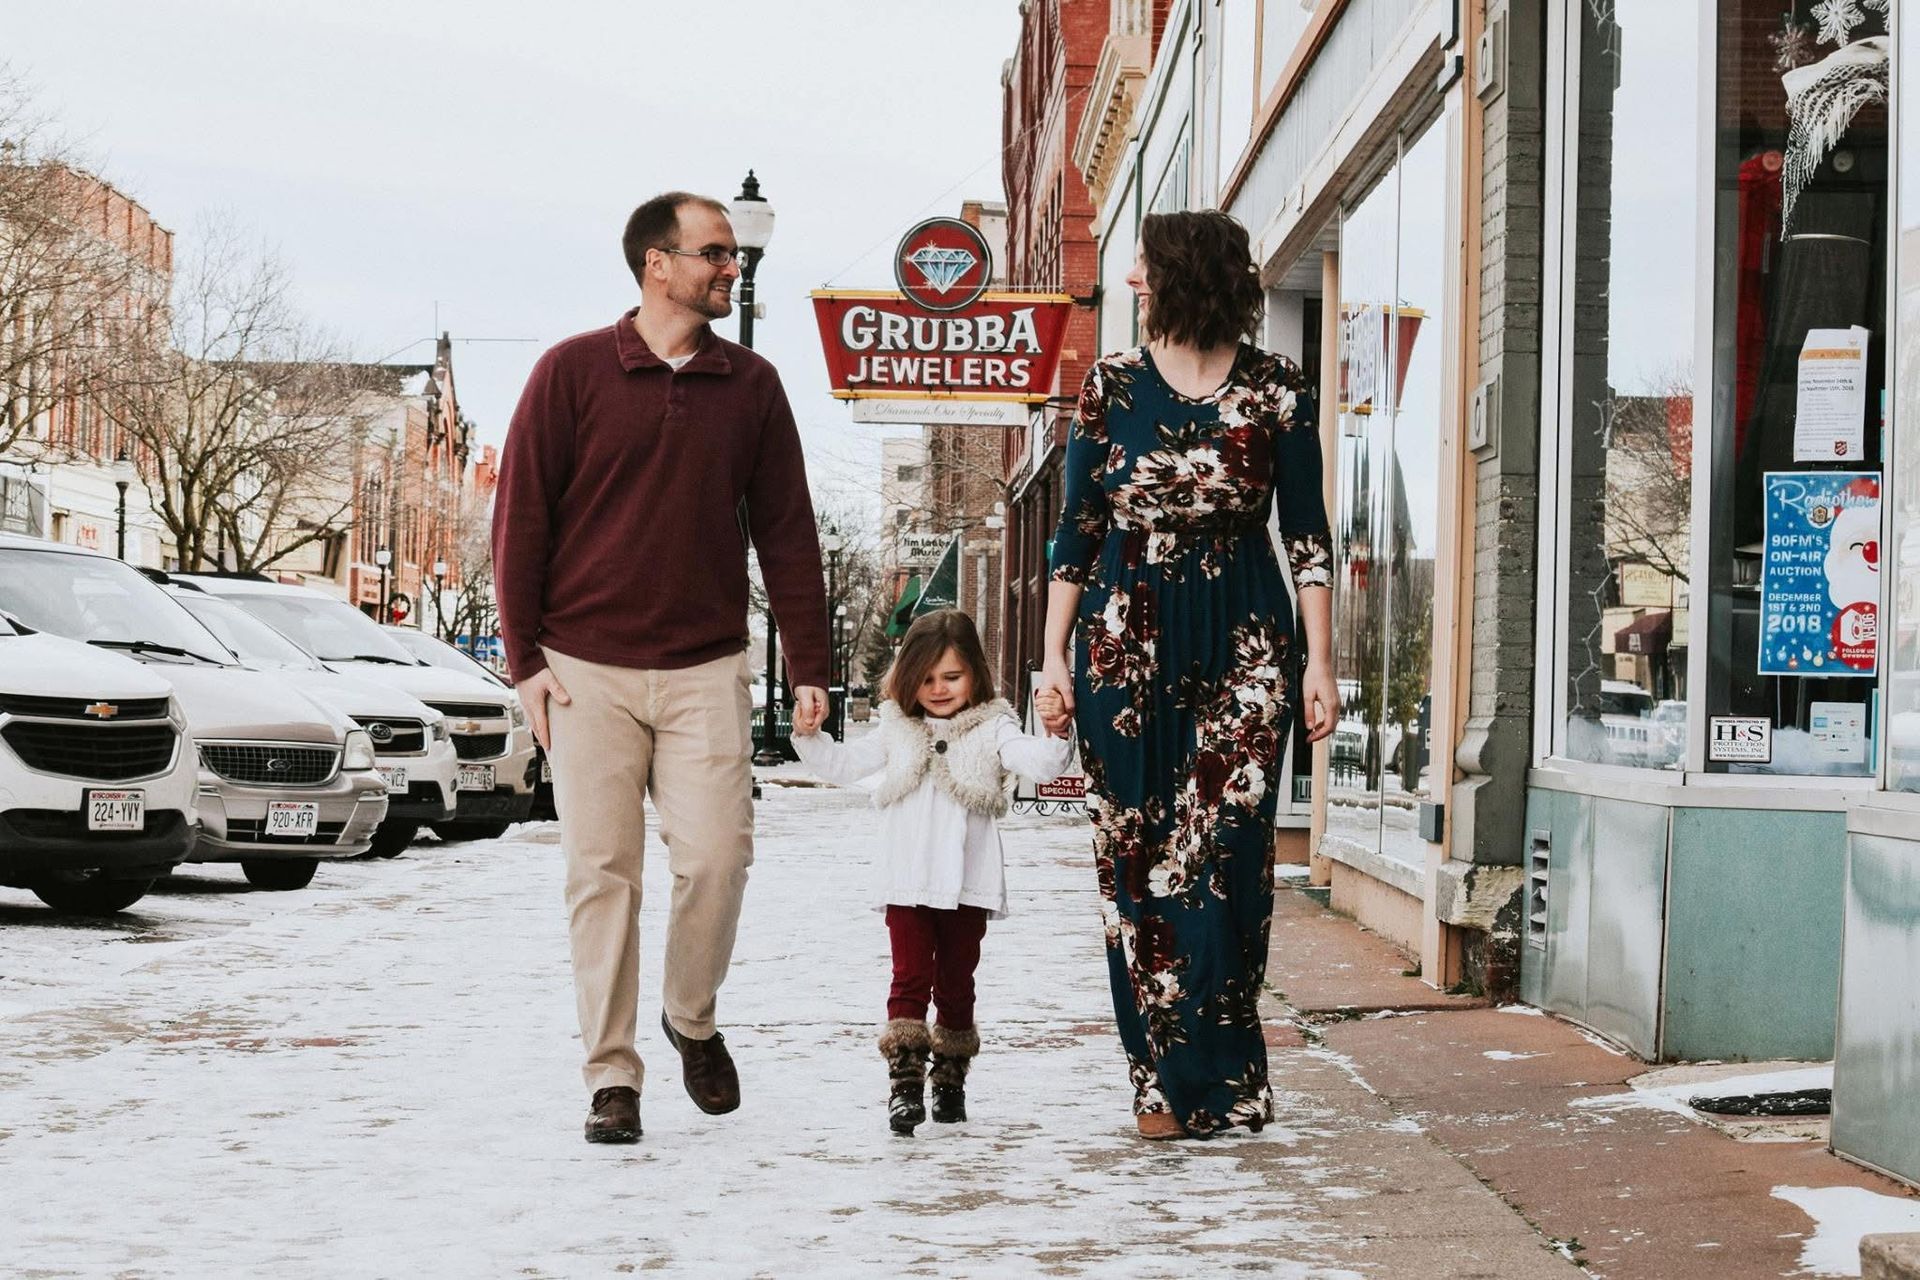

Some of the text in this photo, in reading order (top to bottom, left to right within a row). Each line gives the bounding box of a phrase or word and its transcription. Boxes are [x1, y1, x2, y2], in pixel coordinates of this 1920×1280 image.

[841, 305, 1043, 353] GRUBBA
[847, 355, 1031, 387] JEWELERS
[1768, 480, 1877, 511] Radiothon
[1772, 533, 1823, 547] 90FM'S
[911, 547, 941, 556] Music
[1770, 550, 1822, 562] ON-AIR
[1769, 566, 1822, 576] AUCTION
[1768, 593, 1822, 601] DECEMBER
[1768, 603, 1821, 612] 1ST & 2ND
[1766, 614, 1822, 633] 2018
[1713, 724, 1764, 742] H&S
[1041, 787, 1085, 796] SPECIALTY
[94, 802, 140, 821] 224-YVY
[272, 811, 314, 828] 920-XFR
